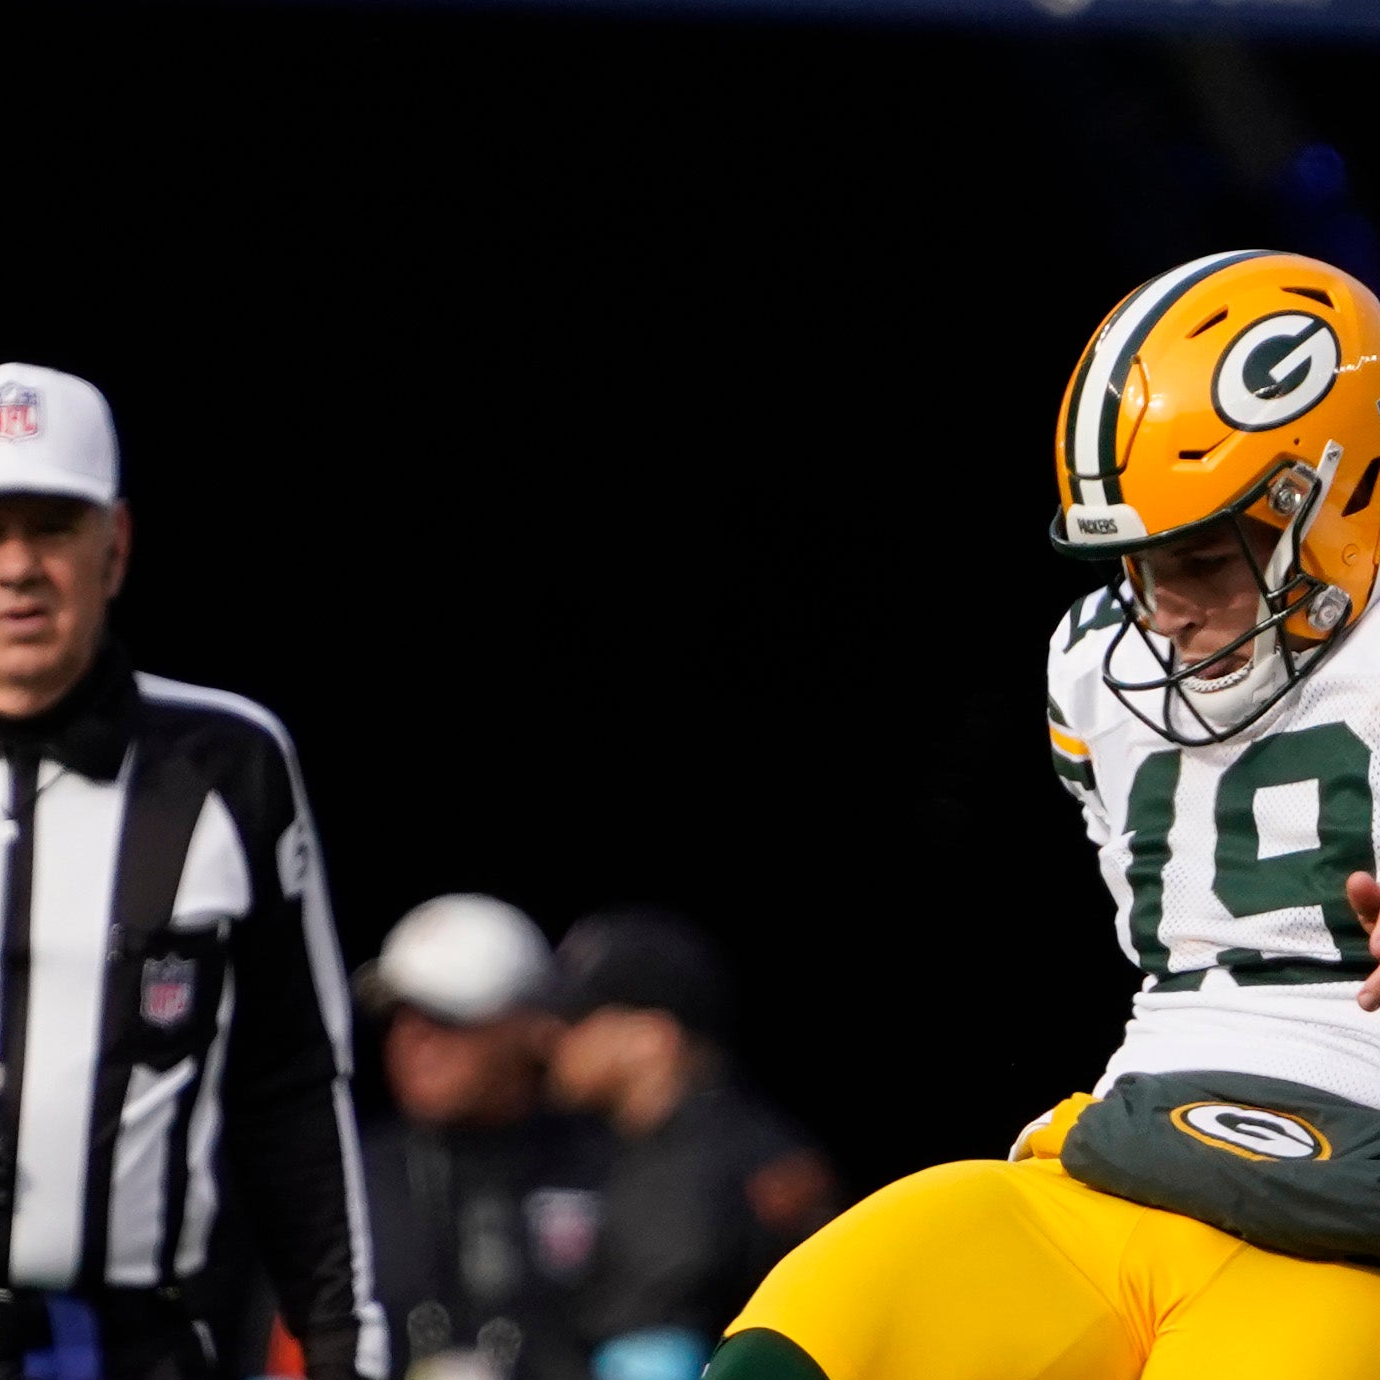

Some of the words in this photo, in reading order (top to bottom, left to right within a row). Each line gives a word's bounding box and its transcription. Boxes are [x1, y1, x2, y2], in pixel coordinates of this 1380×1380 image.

[1214, 312, 1339, 427] G
[1121, 720, 1378, 992] 19
[1186, 1105, 1314, 1158] G
